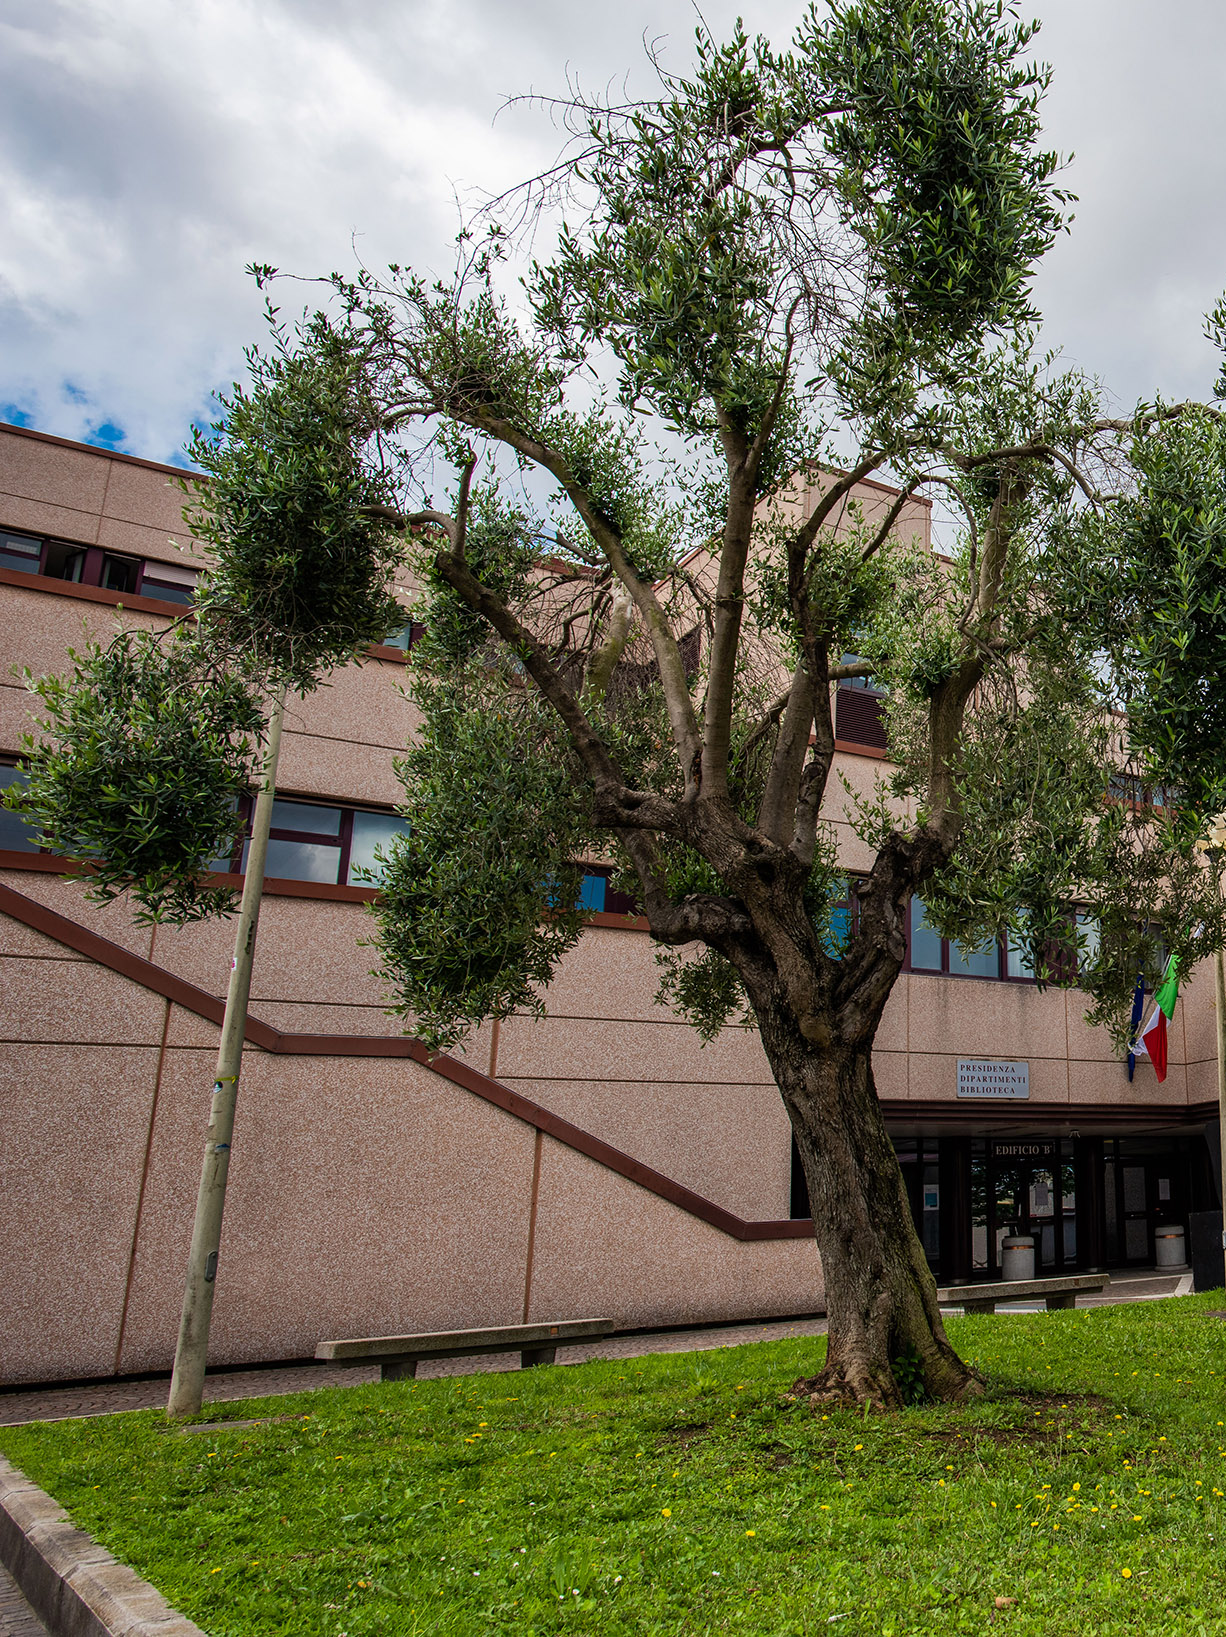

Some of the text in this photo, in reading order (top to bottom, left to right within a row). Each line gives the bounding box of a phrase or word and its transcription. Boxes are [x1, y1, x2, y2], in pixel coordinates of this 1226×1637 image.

[960, 1064, 1016, 1073] PRESIDENZA
[960, 1075, 1026, 1084] DIPARTIMENTI
[960, 1086, 1016, 1094] BIBLIOTECA
[996, 1145, 1040, 1155] EDIFICIO
